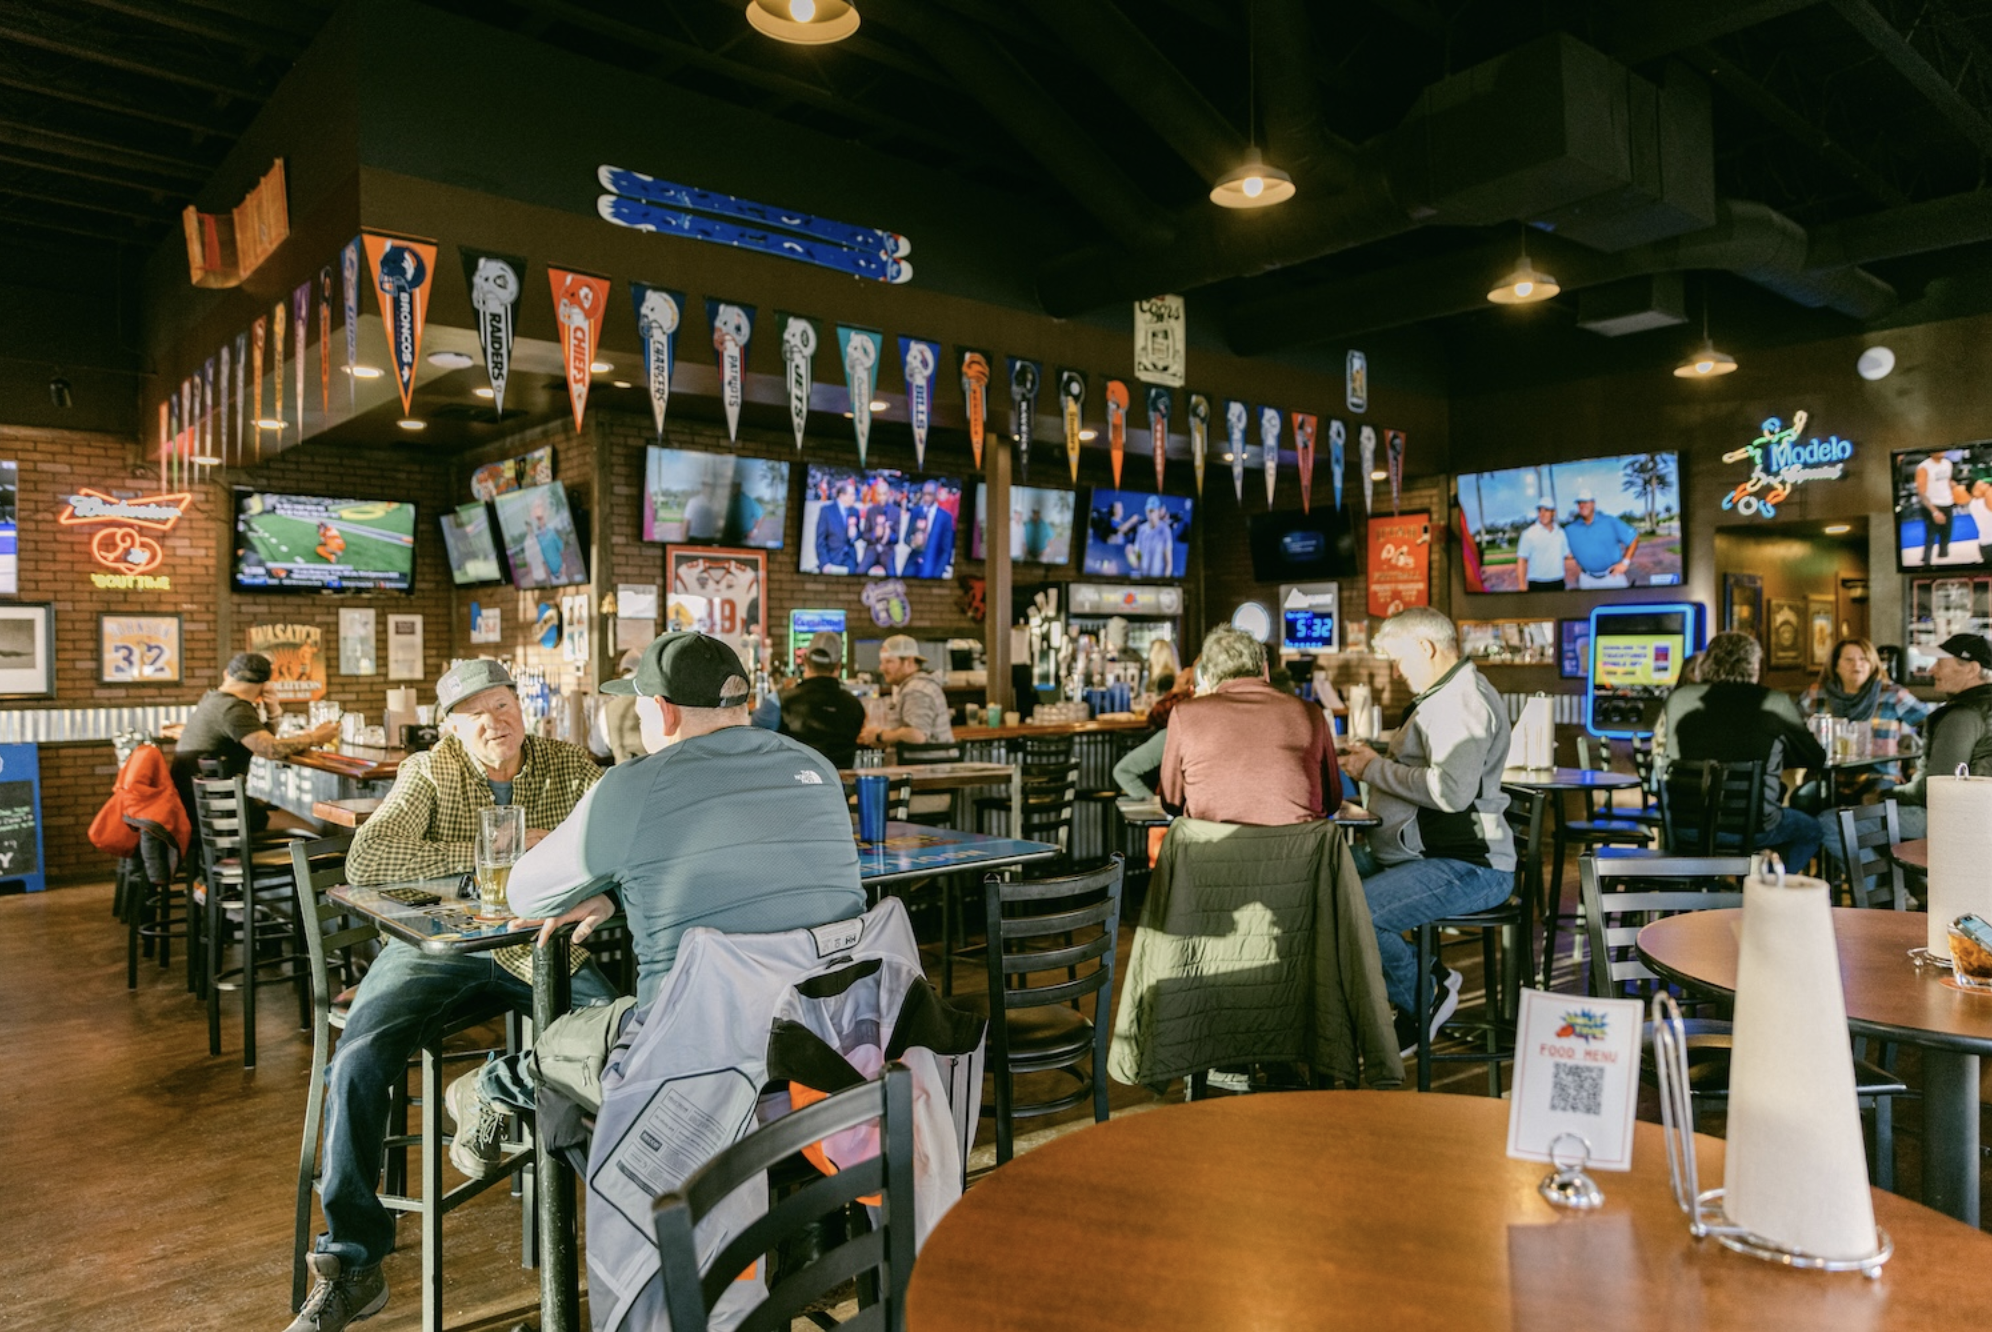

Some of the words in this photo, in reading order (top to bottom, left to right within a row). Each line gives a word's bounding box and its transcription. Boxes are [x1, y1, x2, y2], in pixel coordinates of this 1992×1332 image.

[400, 292, 413, 370] BRONCOS
[489, 312, 504, 382] RAIDERS
[573, 326, 588, 385] CHIEFS
[653, 340, 666, 404] CHARGERS
[728, 354, 739, 408] PATRIOTS
[794, 363, 805, 420] JETS
[915, 384, 925, 429] BILLS
[1770, 435, 1854, 473] Modelo
[250, 624, 322, 645] WASATCH
[1296, 618, 1334, 638] 5:32
[113, 644, 166, 674] 32
[1539, 1043, 1576, 1060] FOOD
[1583, 1049, 1618, 1064] MENU
